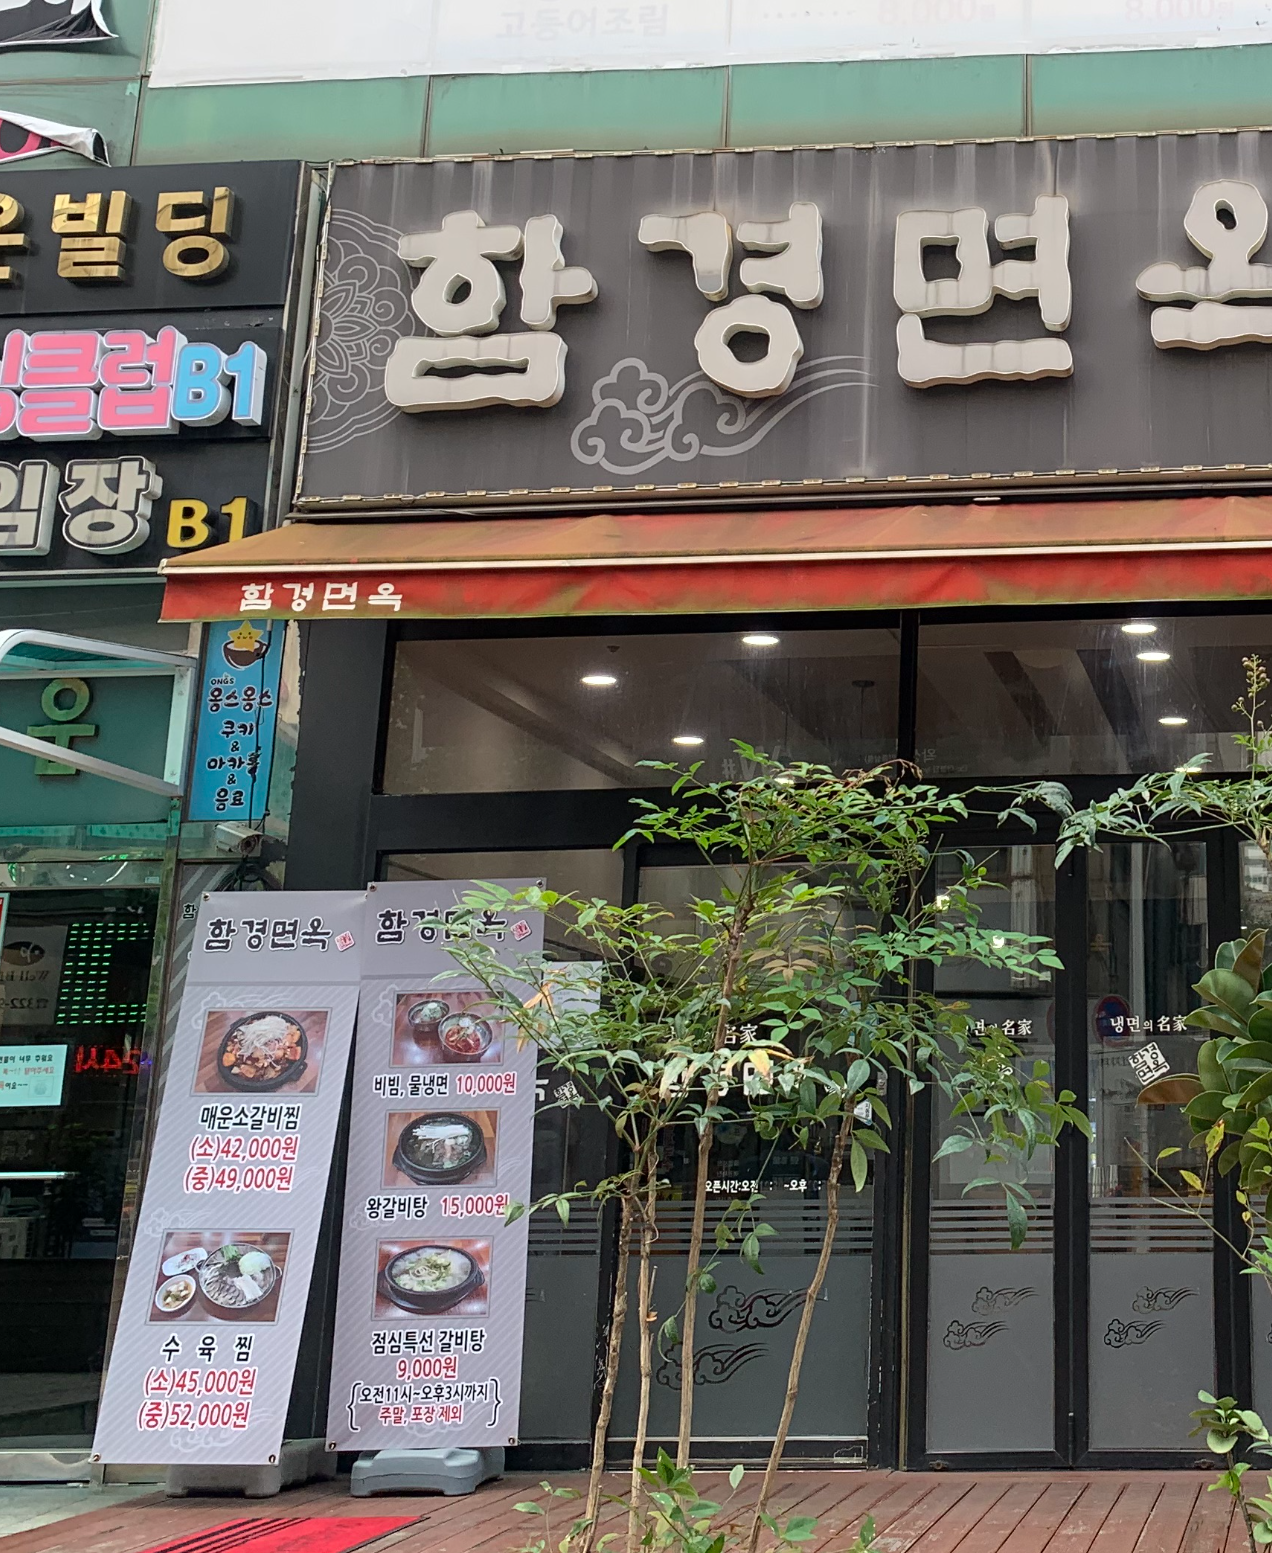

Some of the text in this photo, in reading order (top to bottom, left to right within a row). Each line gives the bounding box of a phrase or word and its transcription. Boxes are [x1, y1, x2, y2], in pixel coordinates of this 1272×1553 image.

[496, 3, 668, 40] 고등어조림
[167, 496, 256, 548] B1
[240, 582, 403, 612] 함경면옥
[221, 720, 254, 738] 쿠키
[204, 917, 332, 951] 함경면옥
[1002, 1018, 1032, 1035] 名家
[1110, 1014, 1187, 1033] 냉면의 名家
[374, 1076, 404, 1097] 비빔,
[409, 1074, 449, 1095] 물냉면
[456, 1072, 517, 1096] 10,000원
[200, 1106, 301, 1131] 매운소갈비찜
[190, 1136, 300, 1162] (소)42,000원
[184, 1167, 294, 1192] (중)49,000원
[366, 1194, 510, 1219] 왕갈비탕 15,000원
[371, 1329, 485, 1355] 점심특선 갈비탕
[397, 1356, 458, 1380] 9,000원
[145, 1368, 257, 1397] (소)45,000원
[138, 1401, 251, 1430] (중)52,000원
[379, 1404, 463, 1425] 주말, 포장 제외
